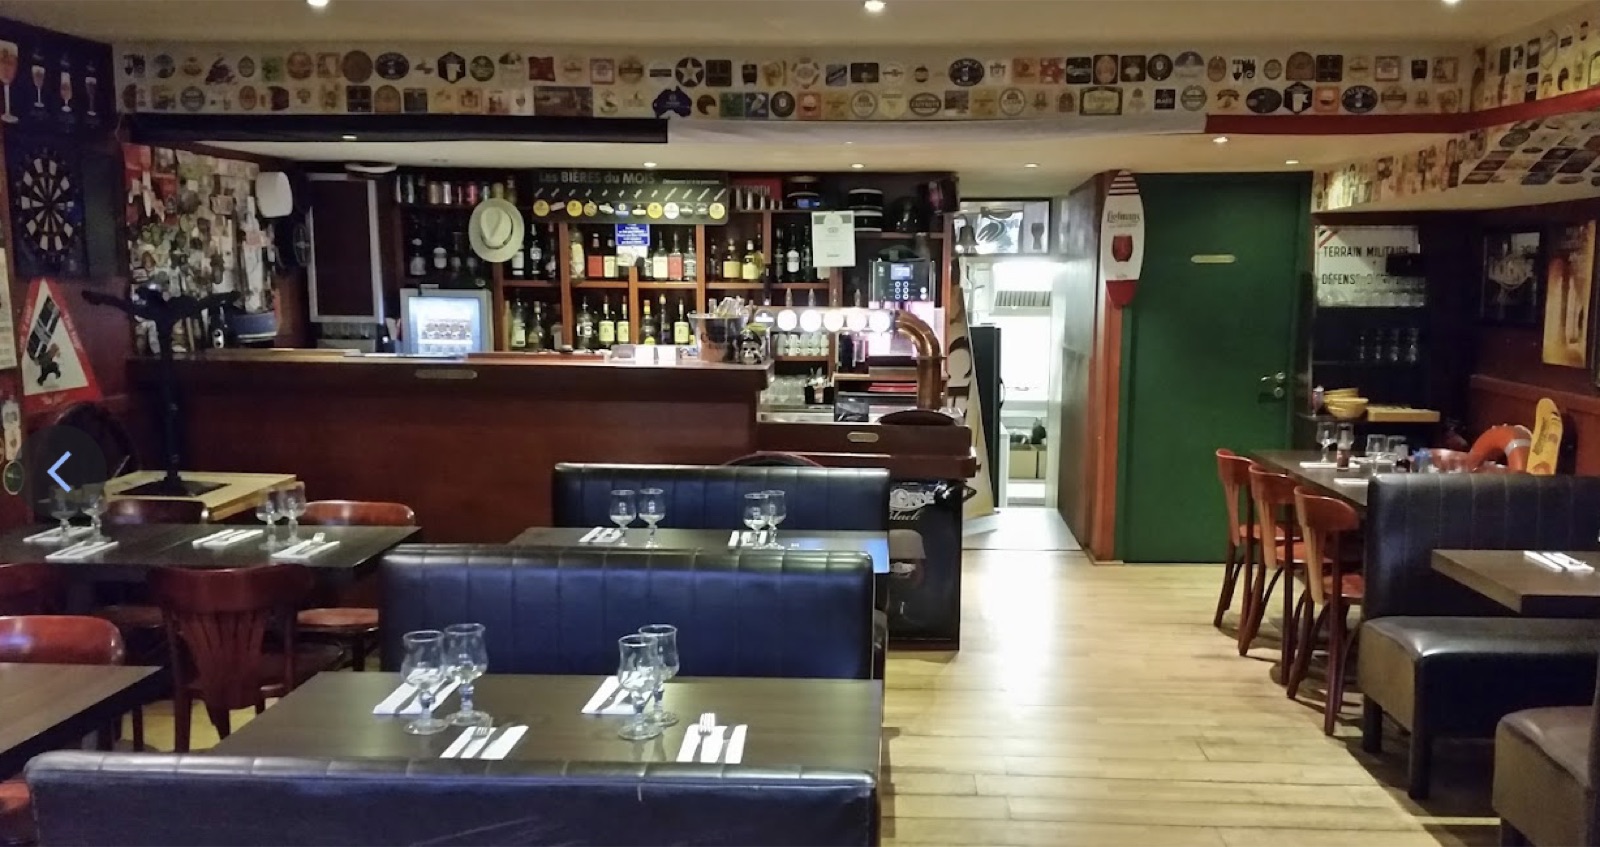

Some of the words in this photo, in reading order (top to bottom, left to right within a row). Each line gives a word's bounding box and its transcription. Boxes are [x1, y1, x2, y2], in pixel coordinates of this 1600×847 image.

[604, 172, 620, 184] du
[622, 172, 655, 184] MOIS
[1323, 245, 1362, 258] TERRAIN
